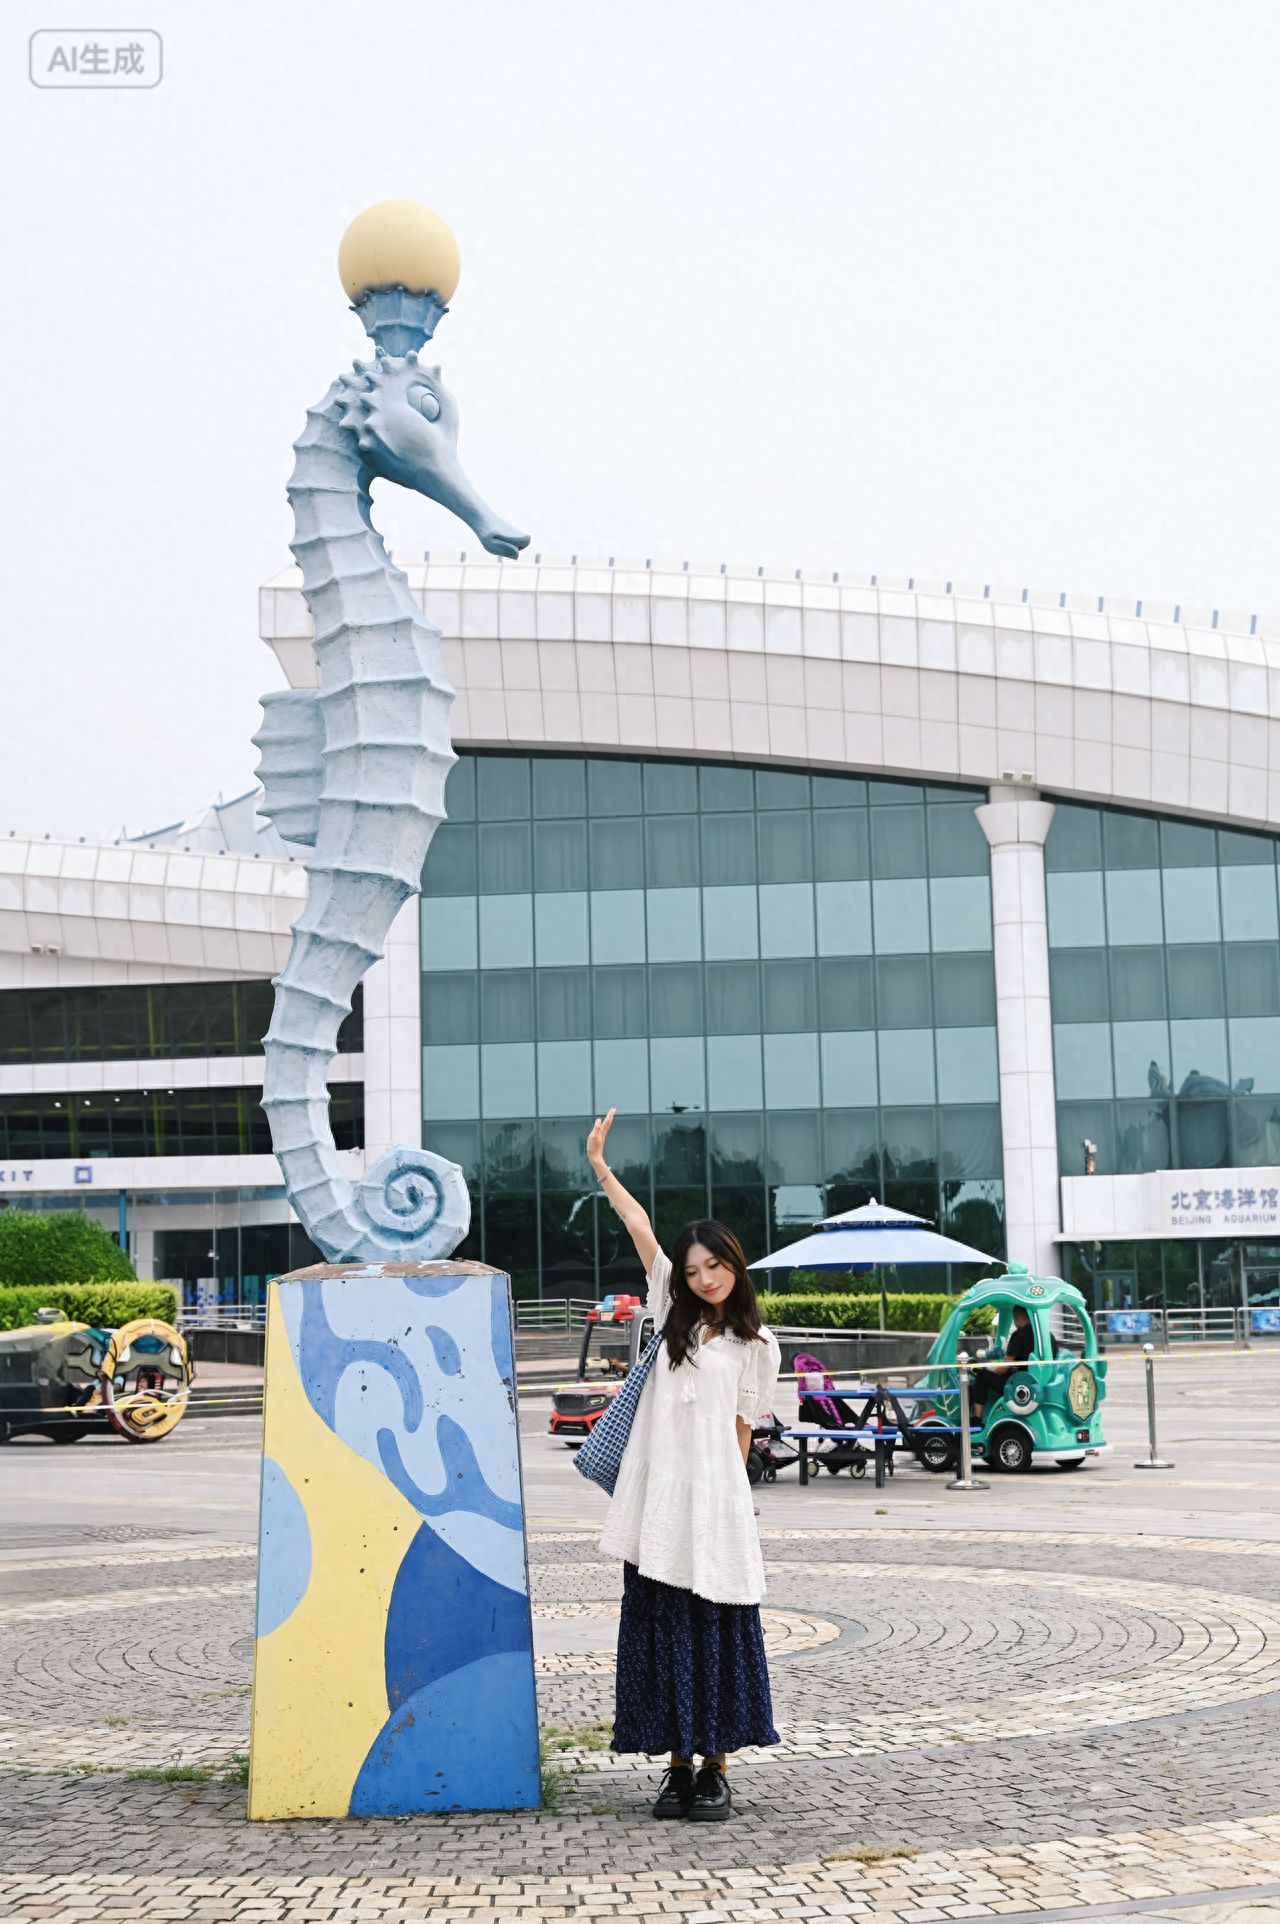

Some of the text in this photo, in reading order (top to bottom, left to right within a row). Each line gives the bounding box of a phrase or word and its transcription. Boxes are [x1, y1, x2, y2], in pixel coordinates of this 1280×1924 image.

[1171, 1188, 1278, 1211] 北京海洋馆
[1171, 1214, 1277, 1225] BEIJING AQUARIUM
